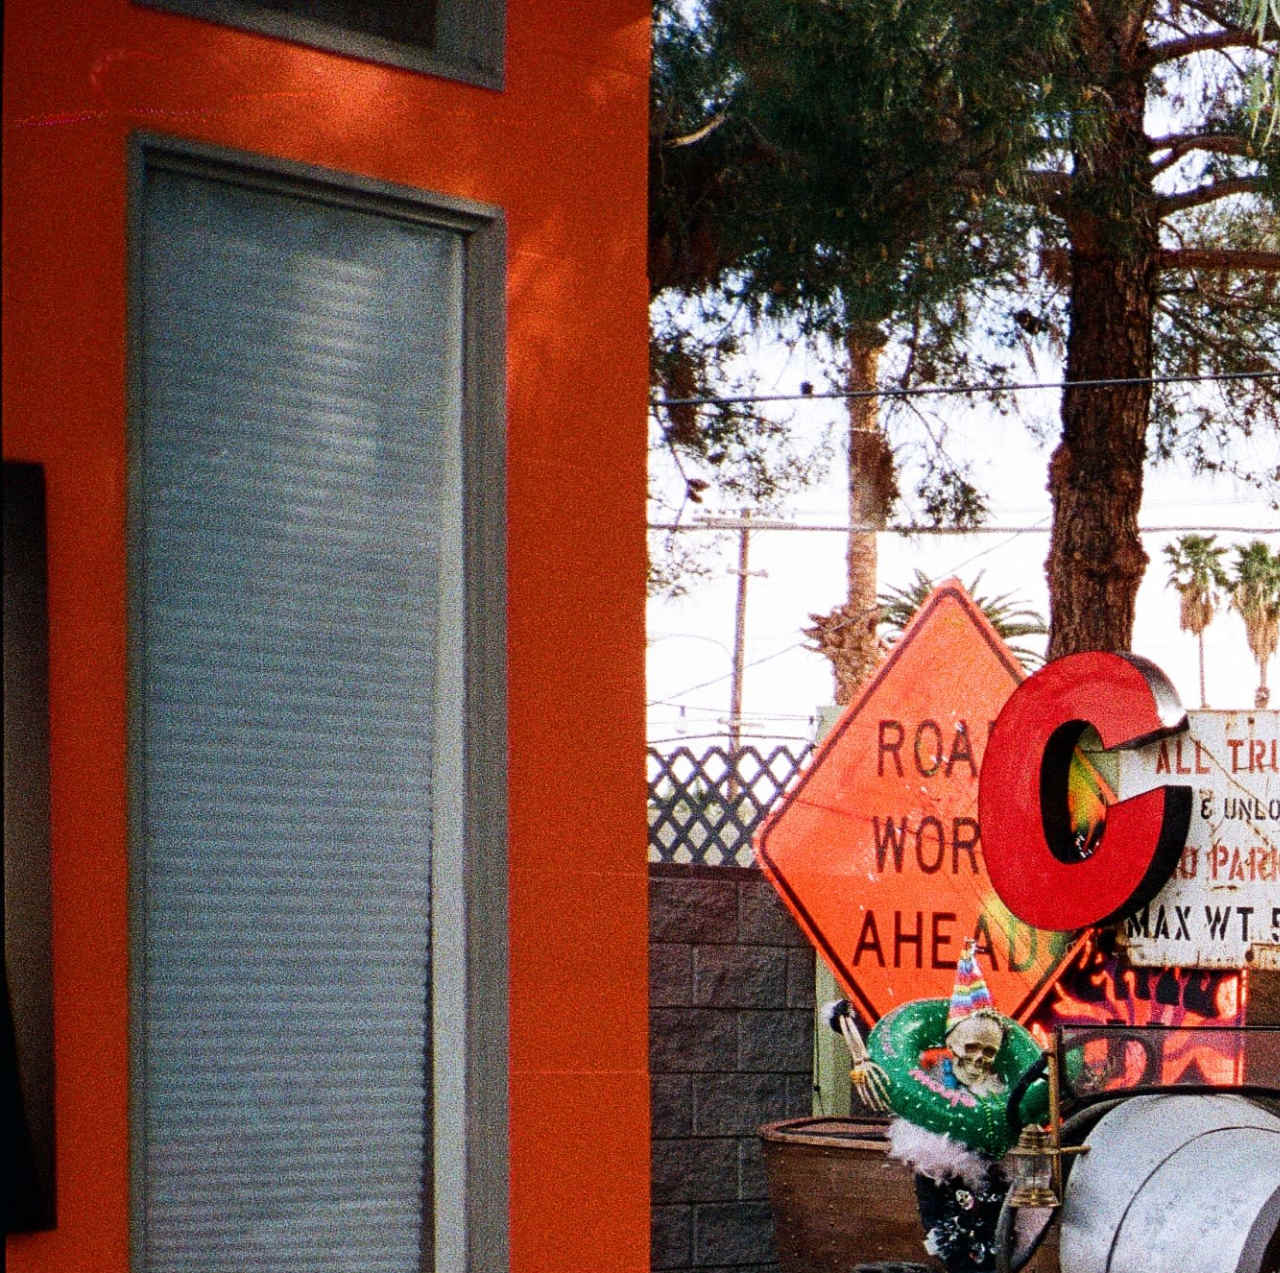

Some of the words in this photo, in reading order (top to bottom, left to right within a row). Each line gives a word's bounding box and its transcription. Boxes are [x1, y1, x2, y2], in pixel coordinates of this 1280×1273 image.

[878, 719, 996, 777] ROA
[1155, 739, 1210, 775] ALL
[978, 651, 1192, 931] C
[871, 816, 981, 874] WOR
[852, 909, 1037, 973] AHEAD
[1126, 904, 1191, 942] MAX
[1205, 905, 1254, 943] WT
